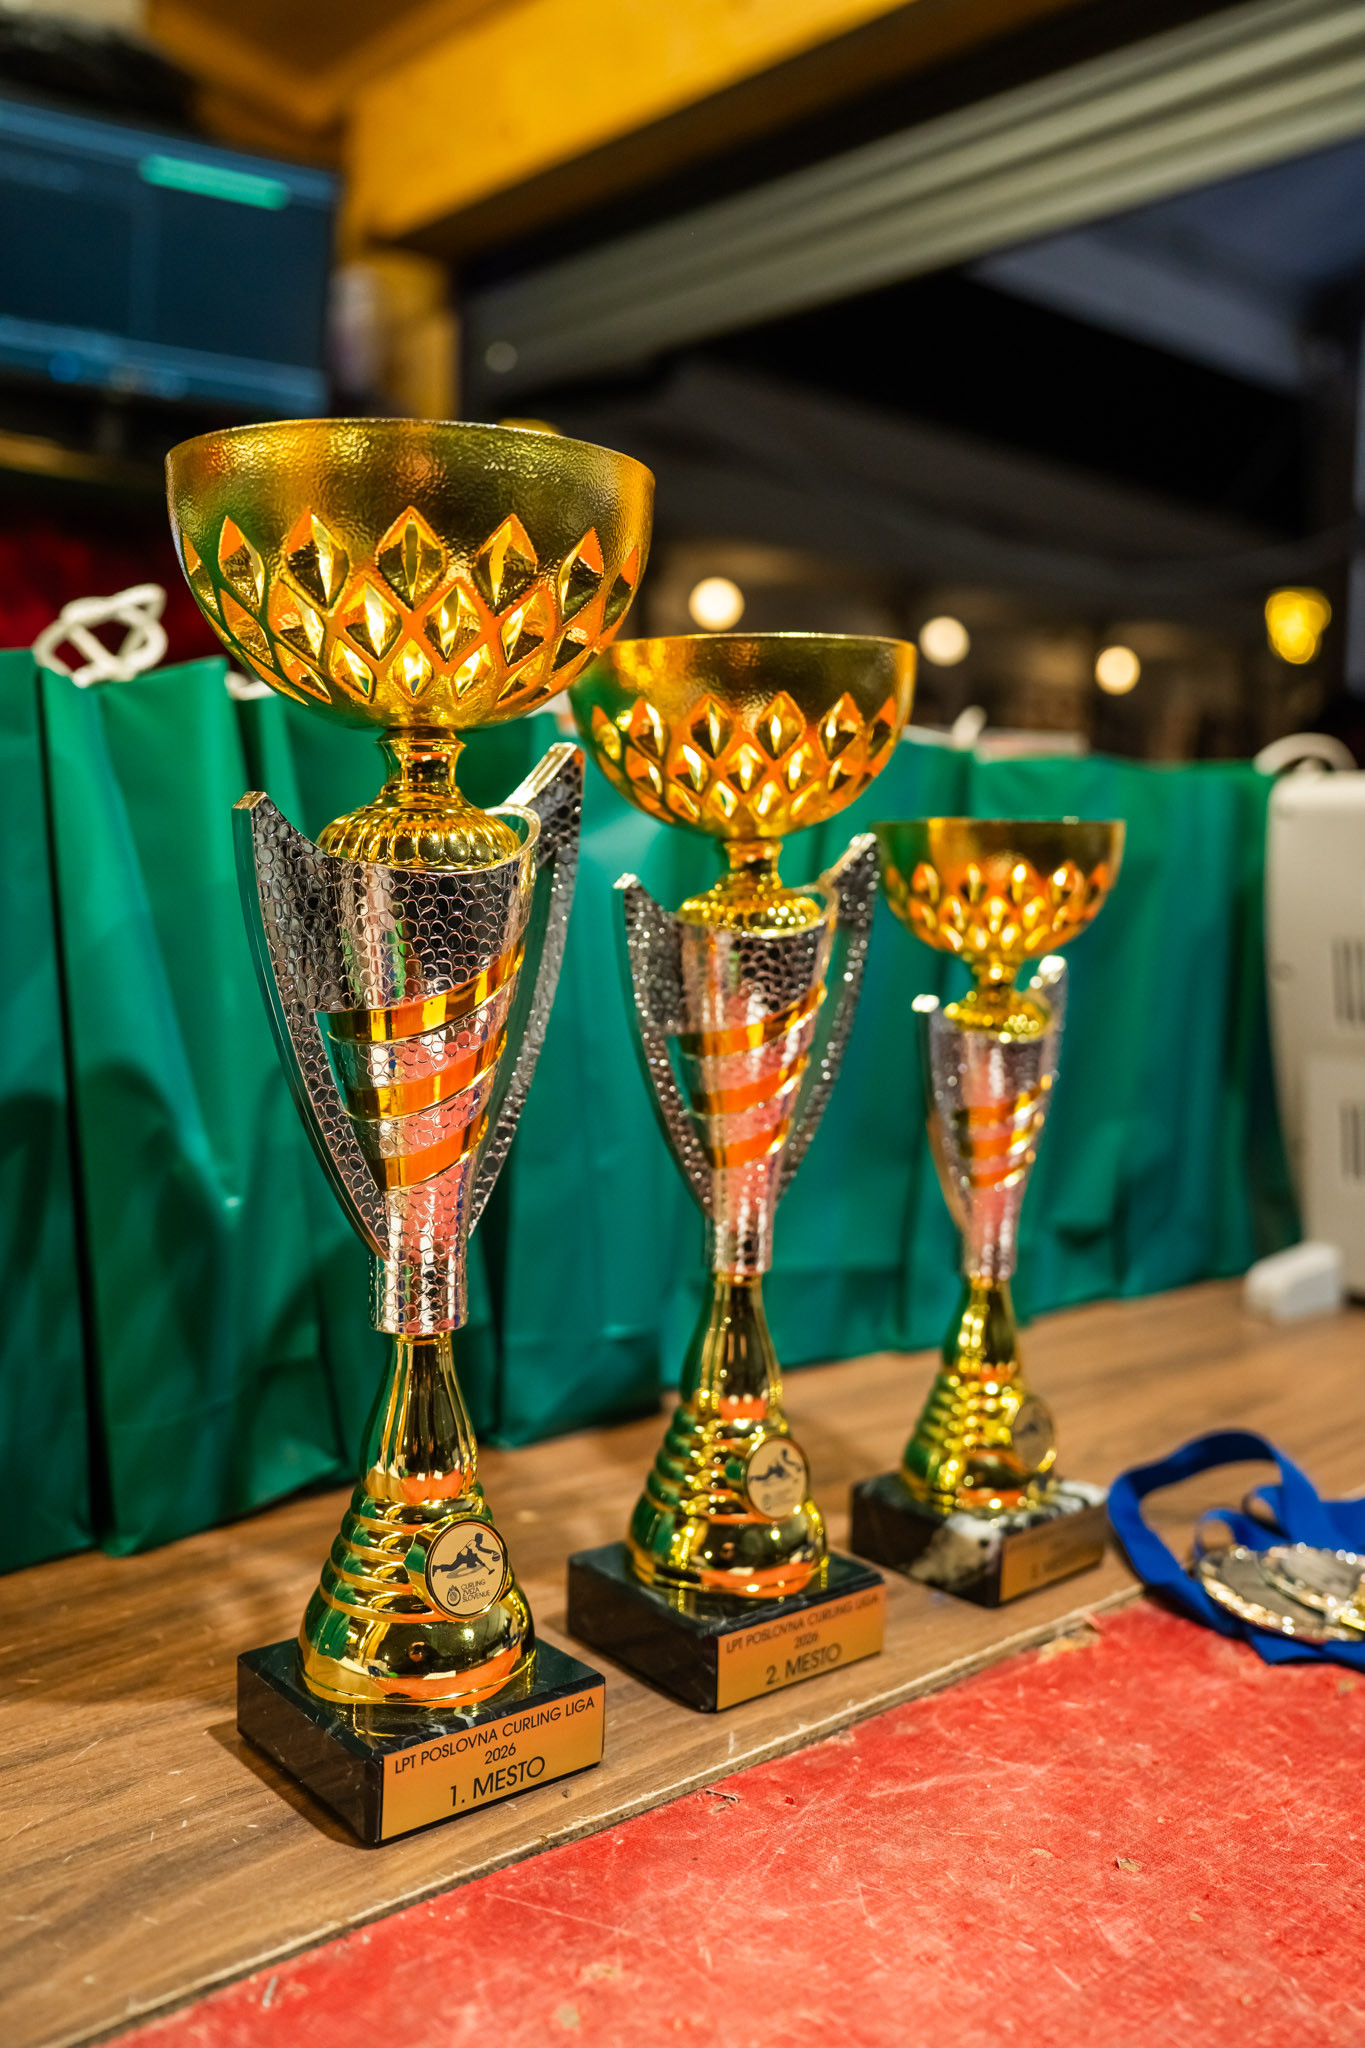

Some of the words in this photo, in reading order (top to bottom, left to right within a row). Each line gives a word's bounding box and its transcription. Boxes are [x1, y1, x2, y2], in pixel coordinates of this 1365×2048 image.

[461, 1579, 486, 1591] CURLING
[725, 1640, 743, 1654] LPT
[746, 1617, 804, 1644] POSLOVNA
[807, 1604, 853, 1625] CURLING
[766, 1664, 780, 1685] 2.
[785, 1643, 842, 1677] MESTO
[394, 1755, 417, 1774] LPT
[421, 1729, 498, 1765] POSLOVNA
[502, 1707, 562, 1737] CURLING
[565, 1696, 595, 1717] LIGA
[484, 1743, 516, 1764] 2026
[450, 1785, 465, 1806] 1.
[473, 1755, 546, 1799] MESTO
